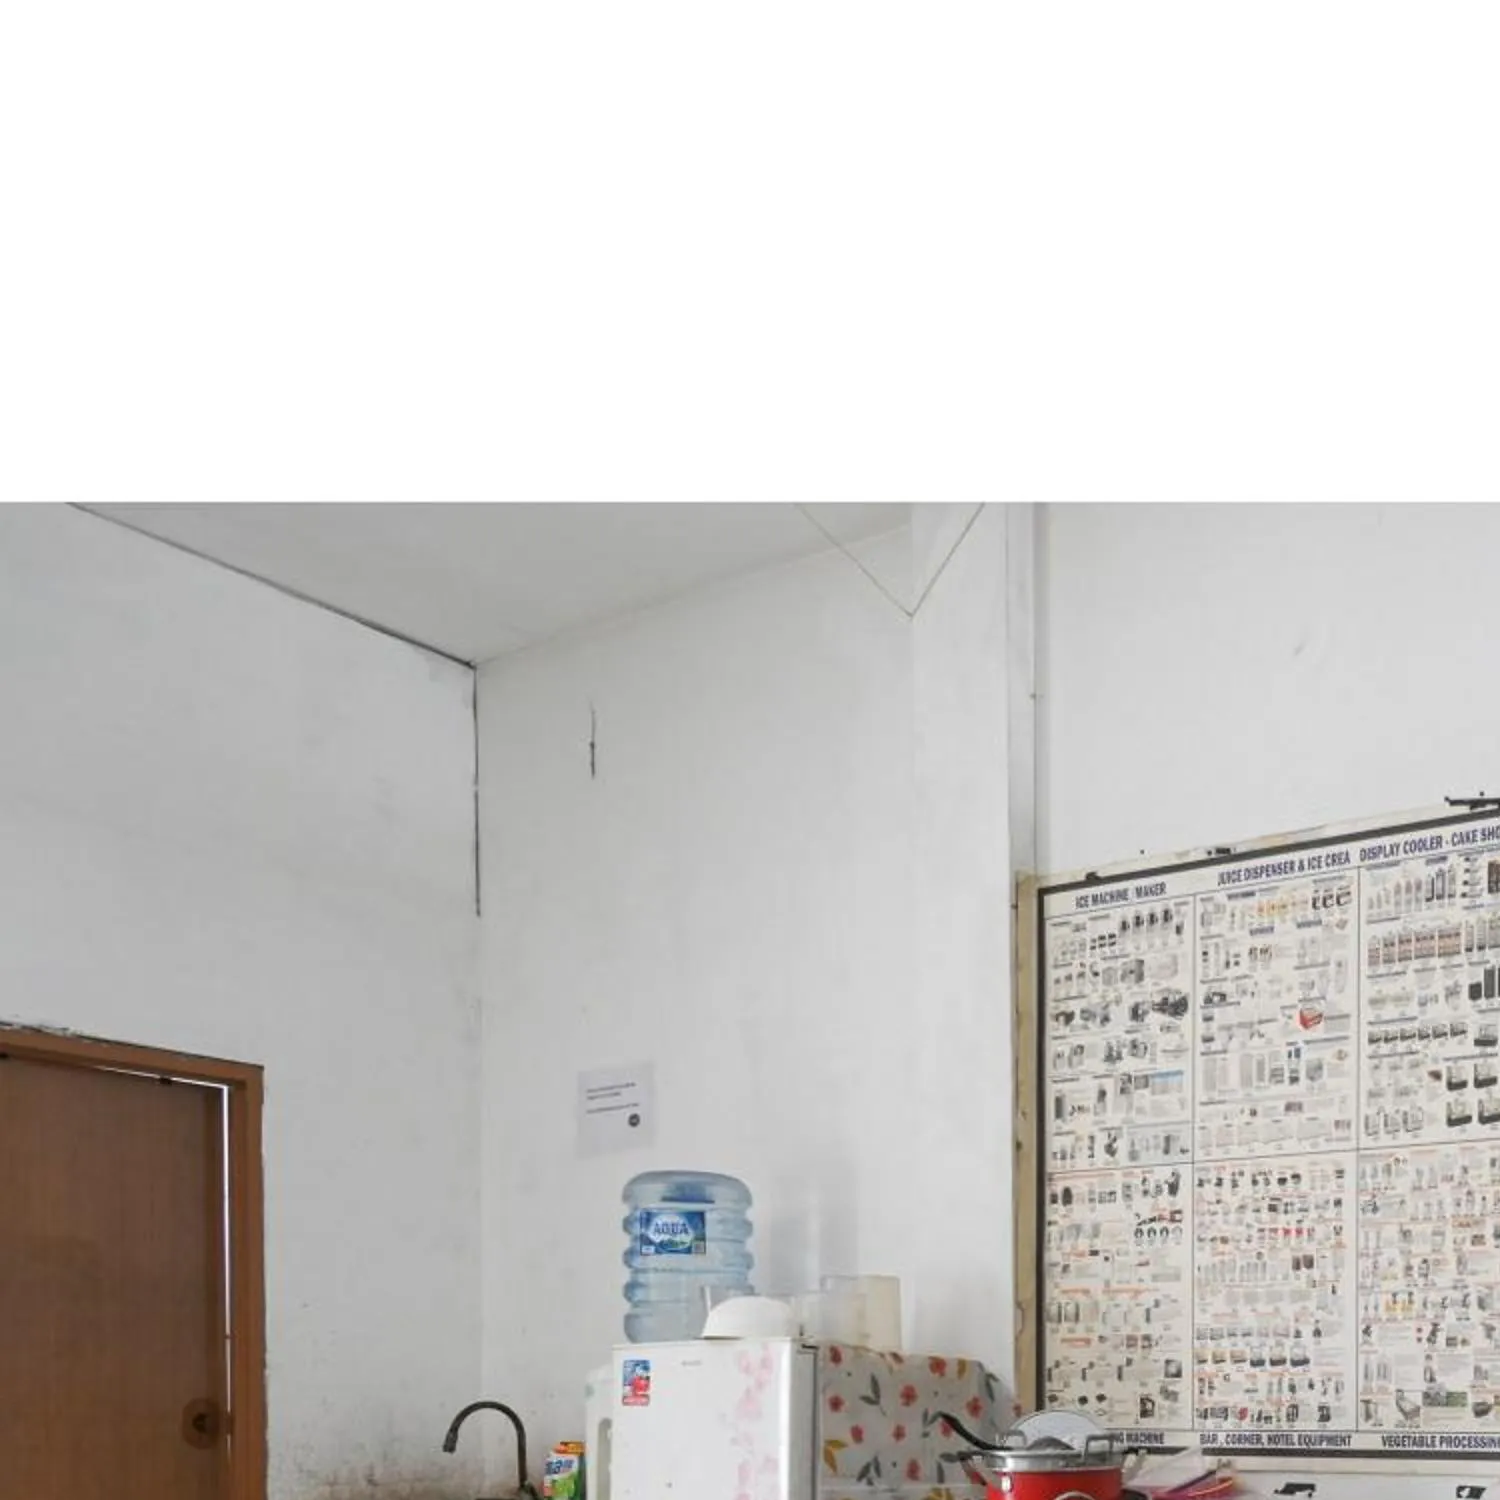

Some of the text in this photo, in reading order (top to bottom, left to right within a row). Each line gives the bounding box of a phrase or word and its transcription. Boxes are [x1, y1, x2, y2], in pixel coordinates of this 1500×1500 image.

[1359, 843, 1400, 862] DISPLAY
[1403, 834, 1443, 854] COOLER
[1451, 827, 1478, 846] CAKE
[1244, 859, 1295, 881] DISPENSER
[1297, 858, 1305, 871] &
[1307, 855, 1322, 870] ICE
[1075, 895, 1089, 909] ICE
[1135, 882, 1167, 898] MAKER
[654, 1221, 689, 1236] AQUA
[1298, 1435, 1352, 1448] EQUIPMENT
[1381, 1435, 1437, 1448] VEGETABLE
